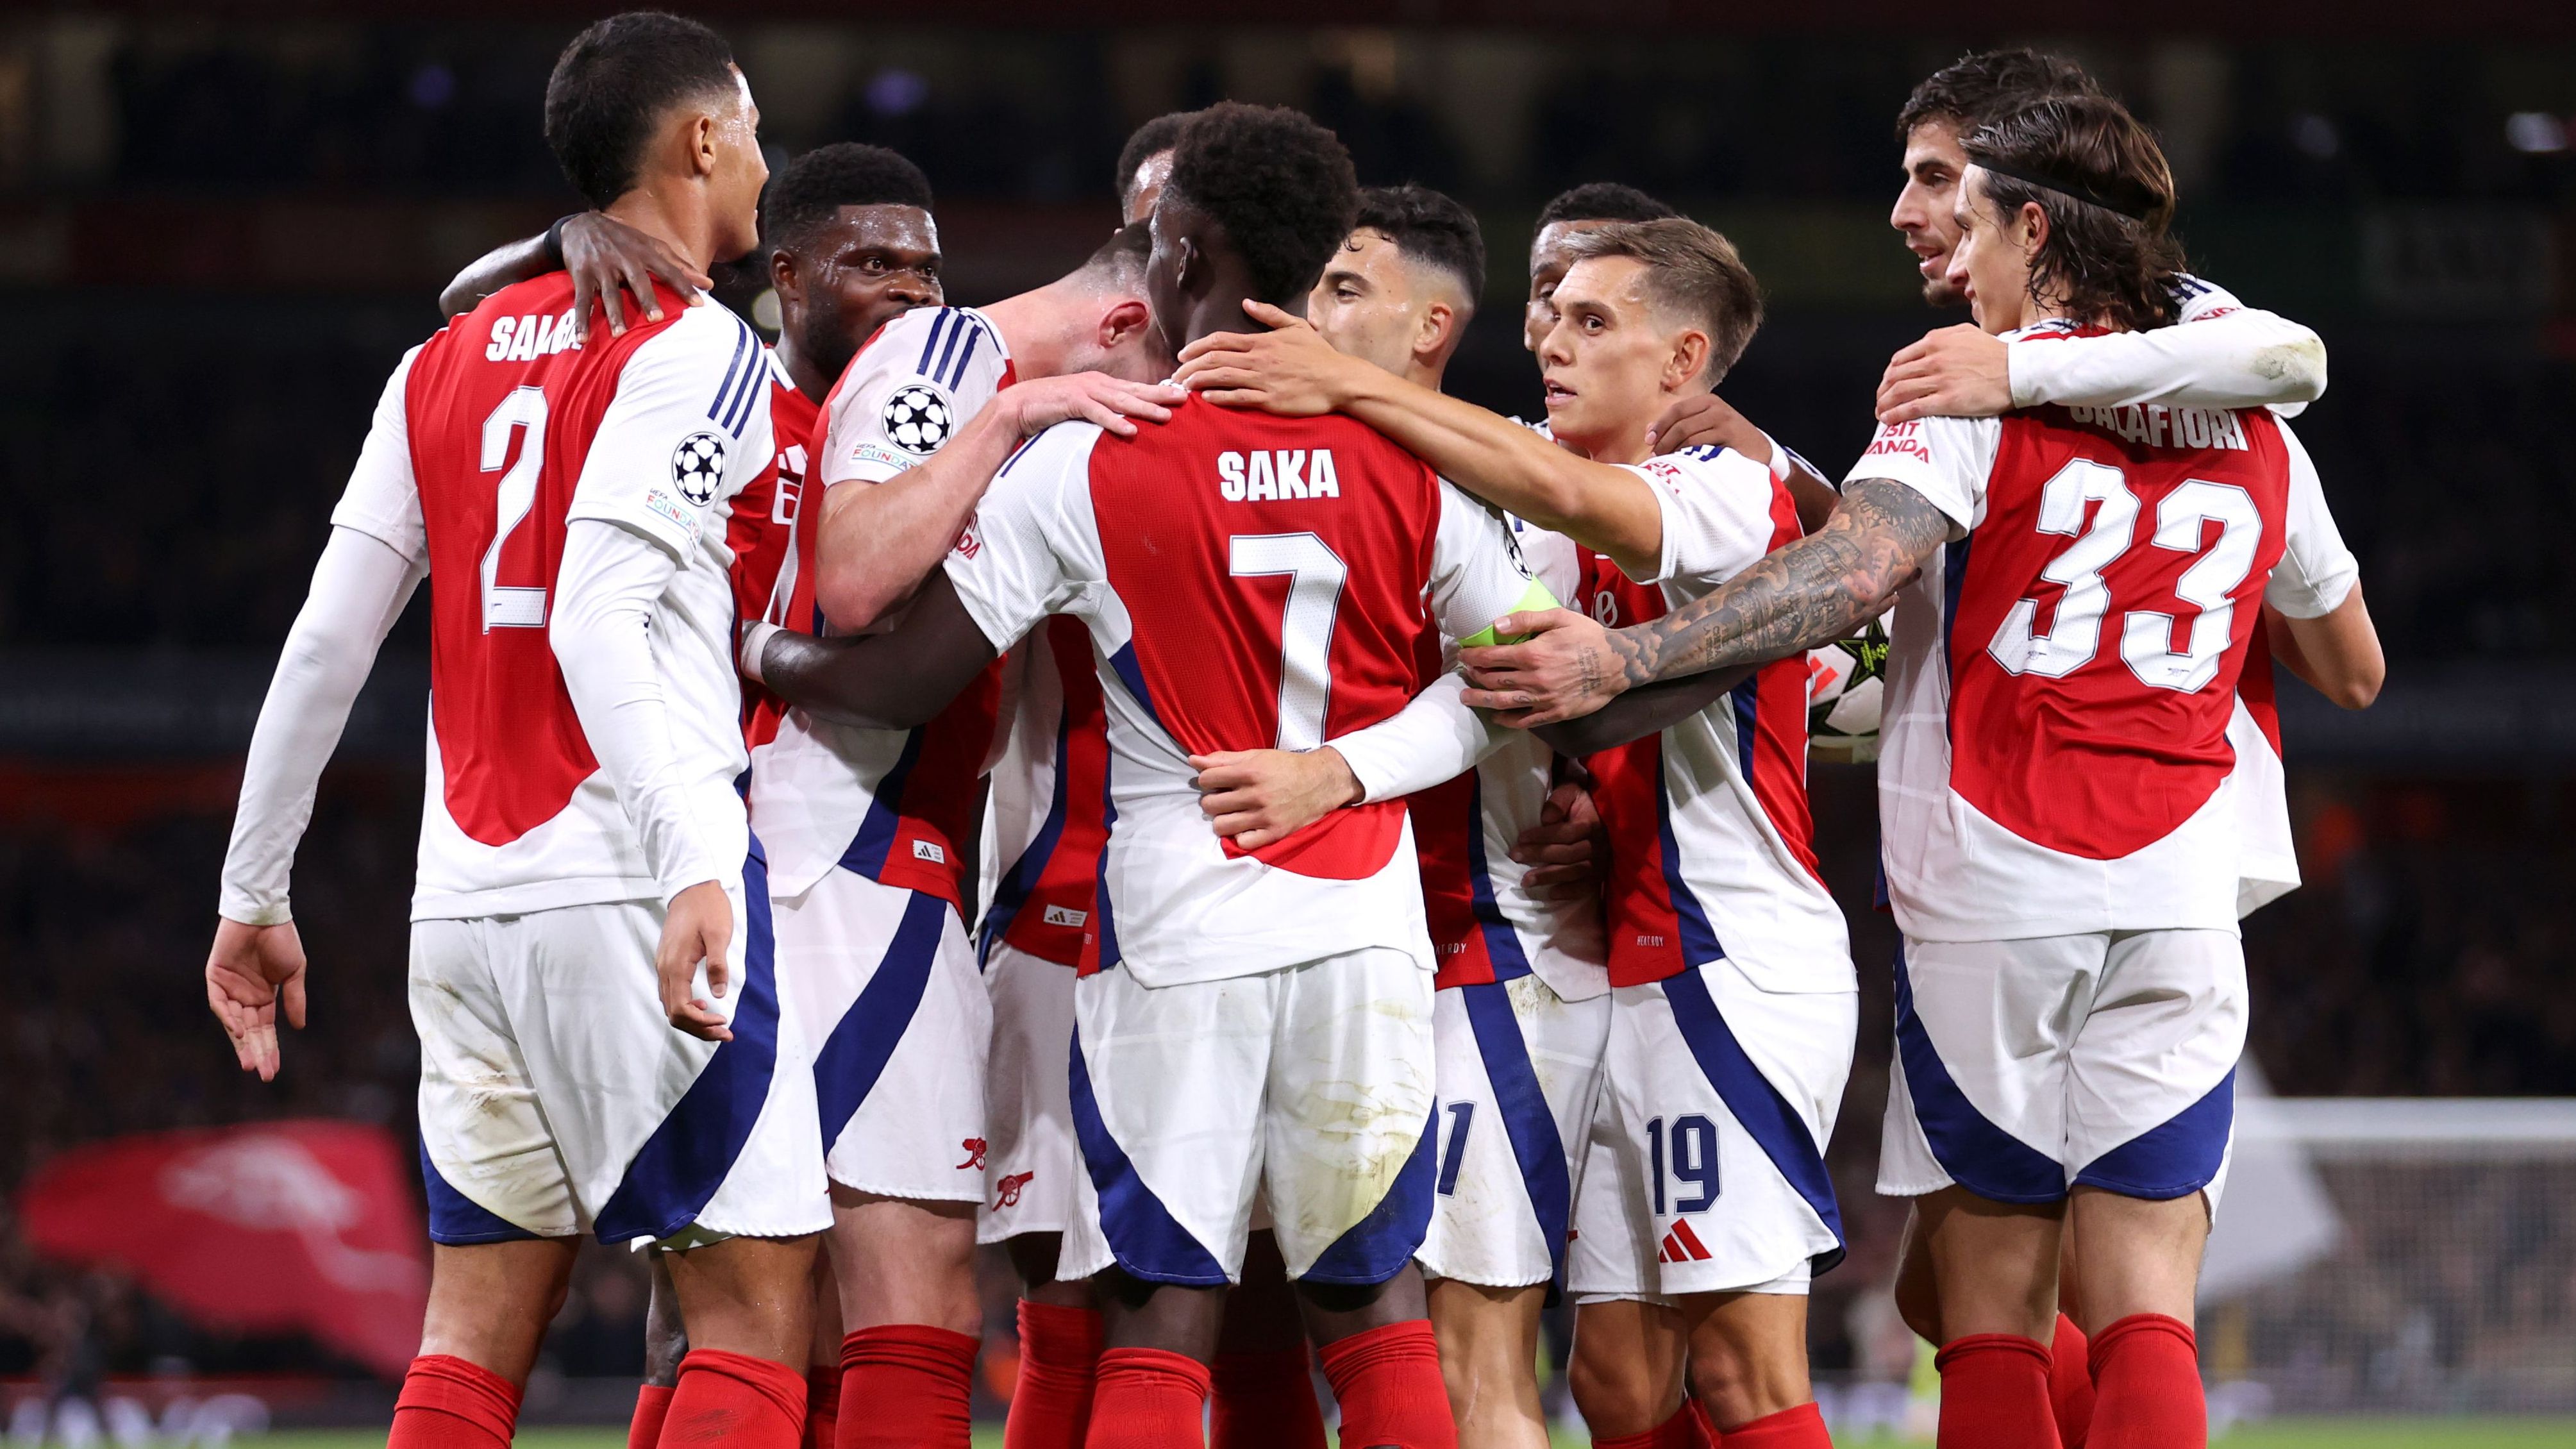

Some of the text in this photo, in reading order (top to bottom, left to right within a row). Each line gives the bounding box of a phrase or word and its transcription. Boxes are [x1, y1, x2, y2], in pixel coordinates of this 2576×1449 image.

[649, 488, 668, 500] UEFA
[1217, 449, 1340, 502] SAKA
[1866, 439, 1928, 464] ANDA
[480, 385, 548, 634] 2
[1986, 457, 2262, 694] 33
[1230, 532, 1347, 750] 7
[1437, 1100, 1477, 1199] 1
[1646, 1112, 1723, 1216] 19
